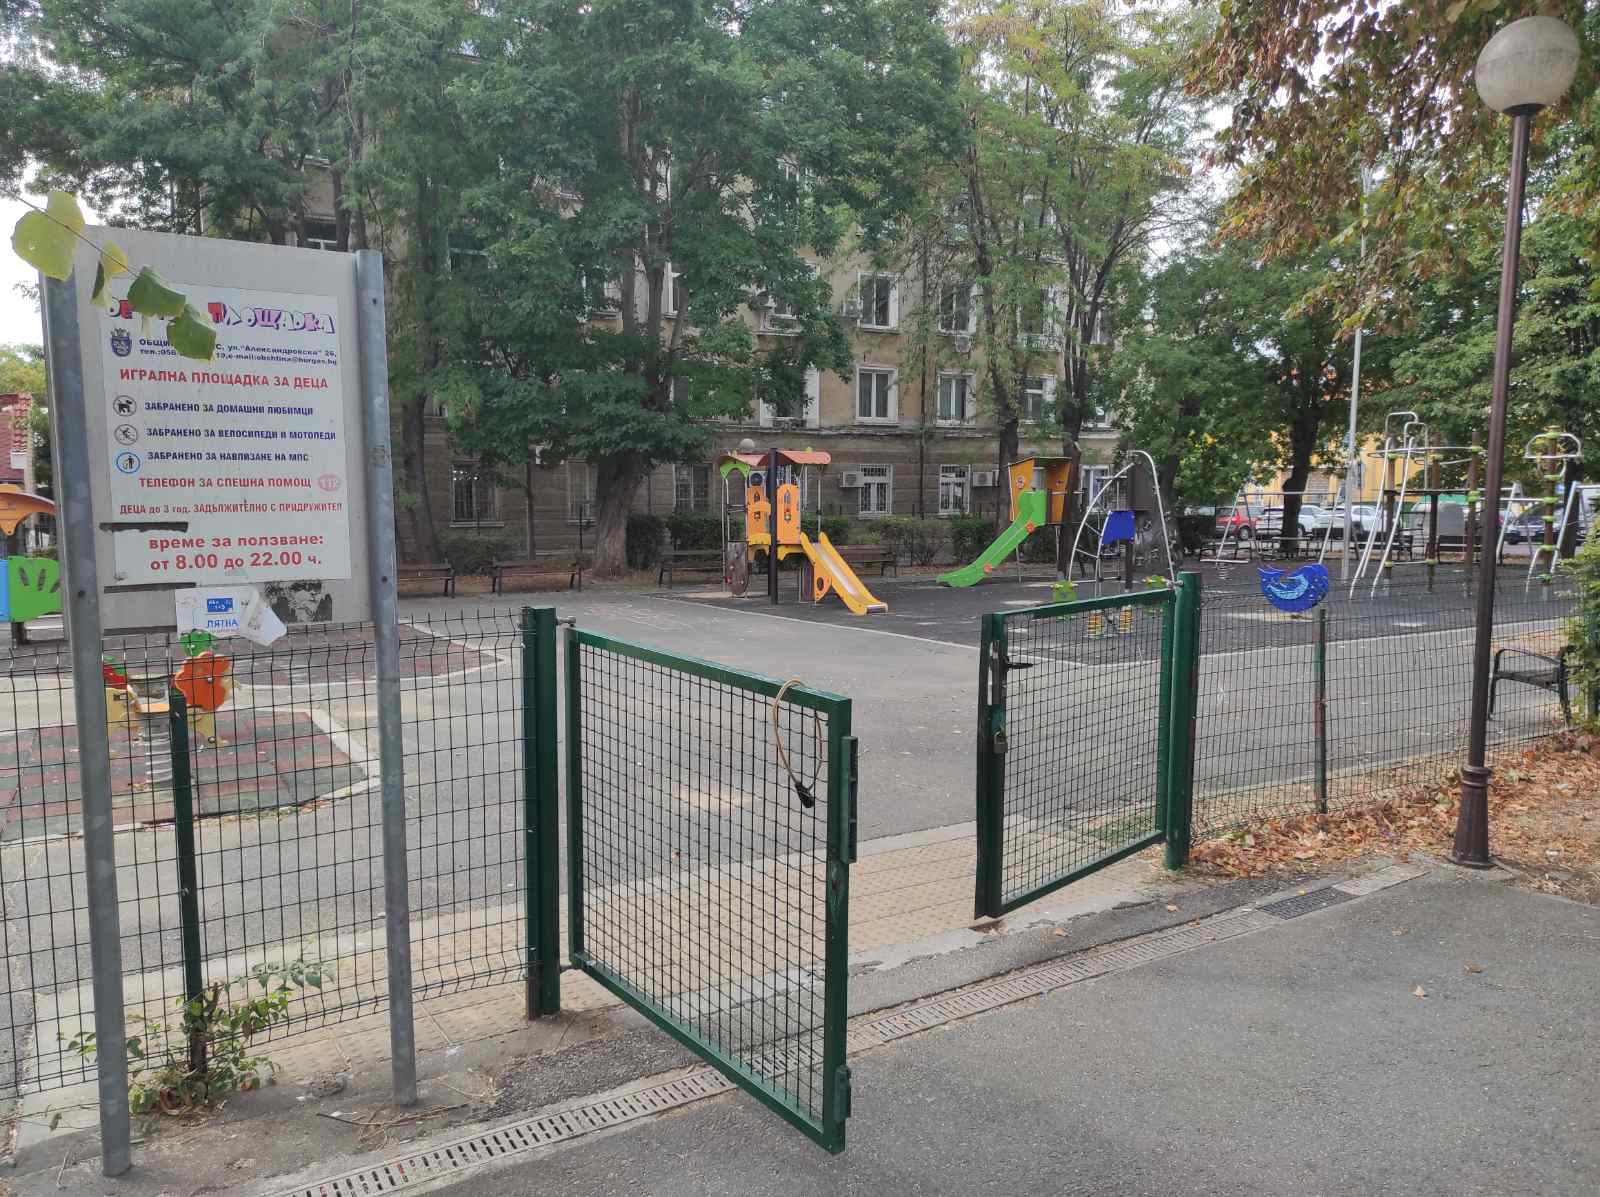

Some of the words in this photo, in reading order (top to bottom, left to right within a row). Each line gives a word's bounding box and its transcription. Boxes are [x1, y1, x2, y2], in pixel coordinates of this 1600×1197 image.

[120, 368, 187, 382] ИГРАЛНА
[191, 371, 269, 387] ПЛОЩАДКА
[273, 376, 289, 387] ЗА
[293, 377, 328, 390] ДЕЦА
[144, 401, 200, 412] ЗАБРАНЕНО
[202, 403, 214, 413] ЗА
[216, 404, 265, 414] ДОМАШНИ
[268, 405, 313, 416] ЛЮБИМЦИ
[146, 428, 201, 438] ЗАБРАНЕНО
[204, 429, 216, 438] ЗА
[218, 429, 278, 440] ВЕЛОСИПЕДИ
[280, 431, 287, 439] И
[289, 431, 336, 441] МОТОПЕДИ
[147, 451, 202, 461] ЗАБРАНЕНО
[205, 452, 217, 461] ЗА
[219, 452, 273, 461] НАВЛИЗАНЕ
[274, 453, 286, 462] НА
[288, 453, 309, 462] МПС
[139, 478, 196, 489] ТЕЛЕФОН
[199, 478, 213, 488] ЗА
[216, 478, 264, 489] СПЕШНА
[268, 478, 312, 490] ПОМОЩ
[119, 504, 146, 515] ДЕЦА
[148, 506, 161, 515] до
[163, 504, 170, 513] 3
[172, 506, 191, 515] год.
[193, 502, 268, 514] ЗАДЪЛЖИТЕЛНО
[279, 502, 342, 513] ПРИДРУЖИТЕЛ
[149, 536, 205, 552] време
[211, 537, 232, 548] за
[237, 534, 324, 547] ползване:
[150, 559, 169, 570] от
[175, 553, 218, 570] 8.00
[224, 557, 245, 570] до
[250, 551, 302, 567] 22.00
[307, 555, 322, 566] ч.
